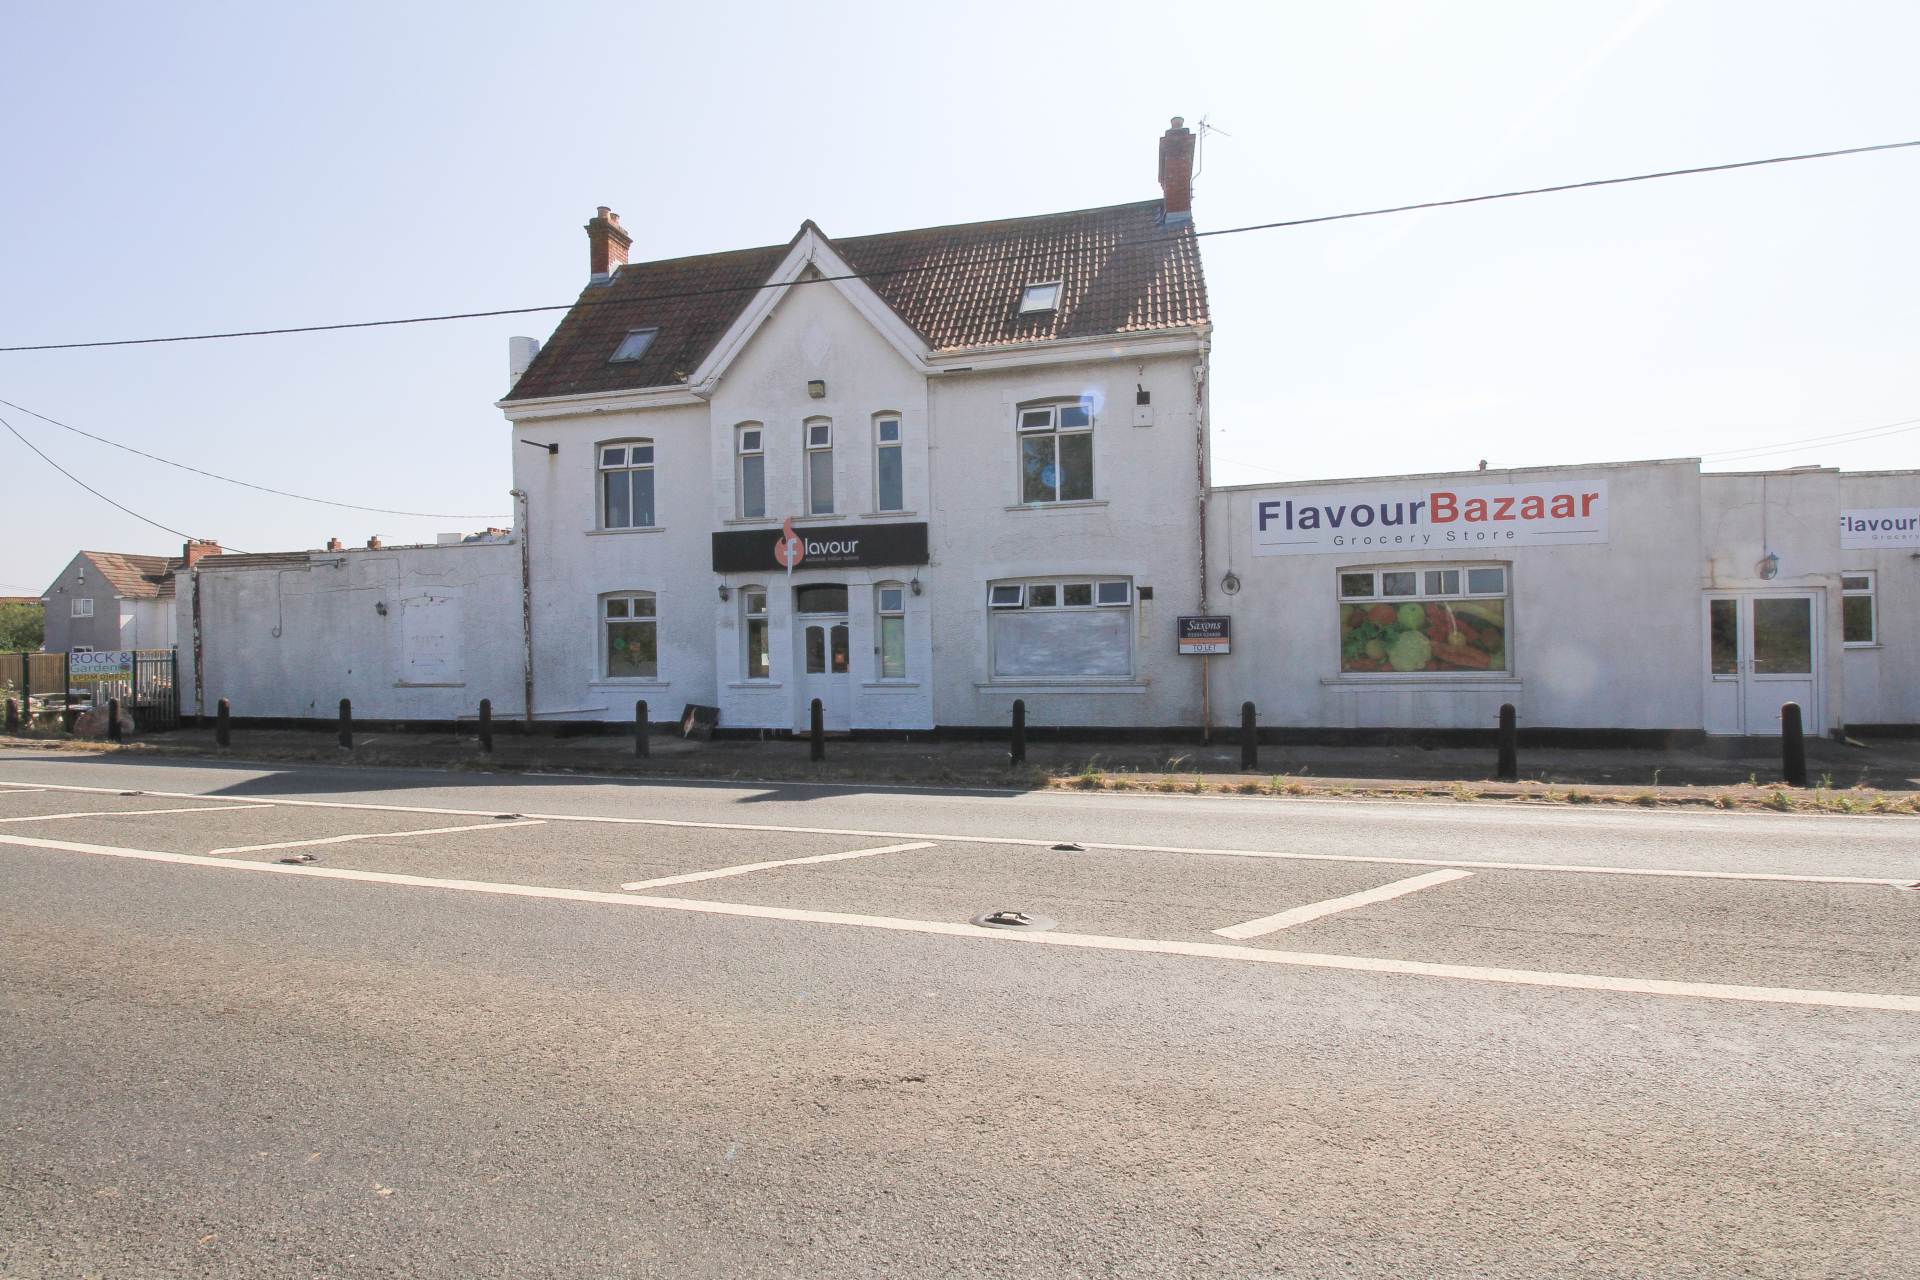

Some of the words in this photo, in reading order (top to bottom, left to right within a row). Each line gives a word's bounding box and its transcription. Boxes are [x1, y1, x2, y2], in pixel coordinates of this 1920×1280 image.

[1840, 516, 1920, 531] Flavour
[1333, 534, 1431, 545] Grocery
[1446, 530, 1515, 542] Store
[783, 537, 859, 577] flavour
[1186, 620, 1222, 632] Saxons
[70, 653, 114, 664] ROCK
[119, 652, 131, 663] &
[70, 664, 118, 673] Garden
